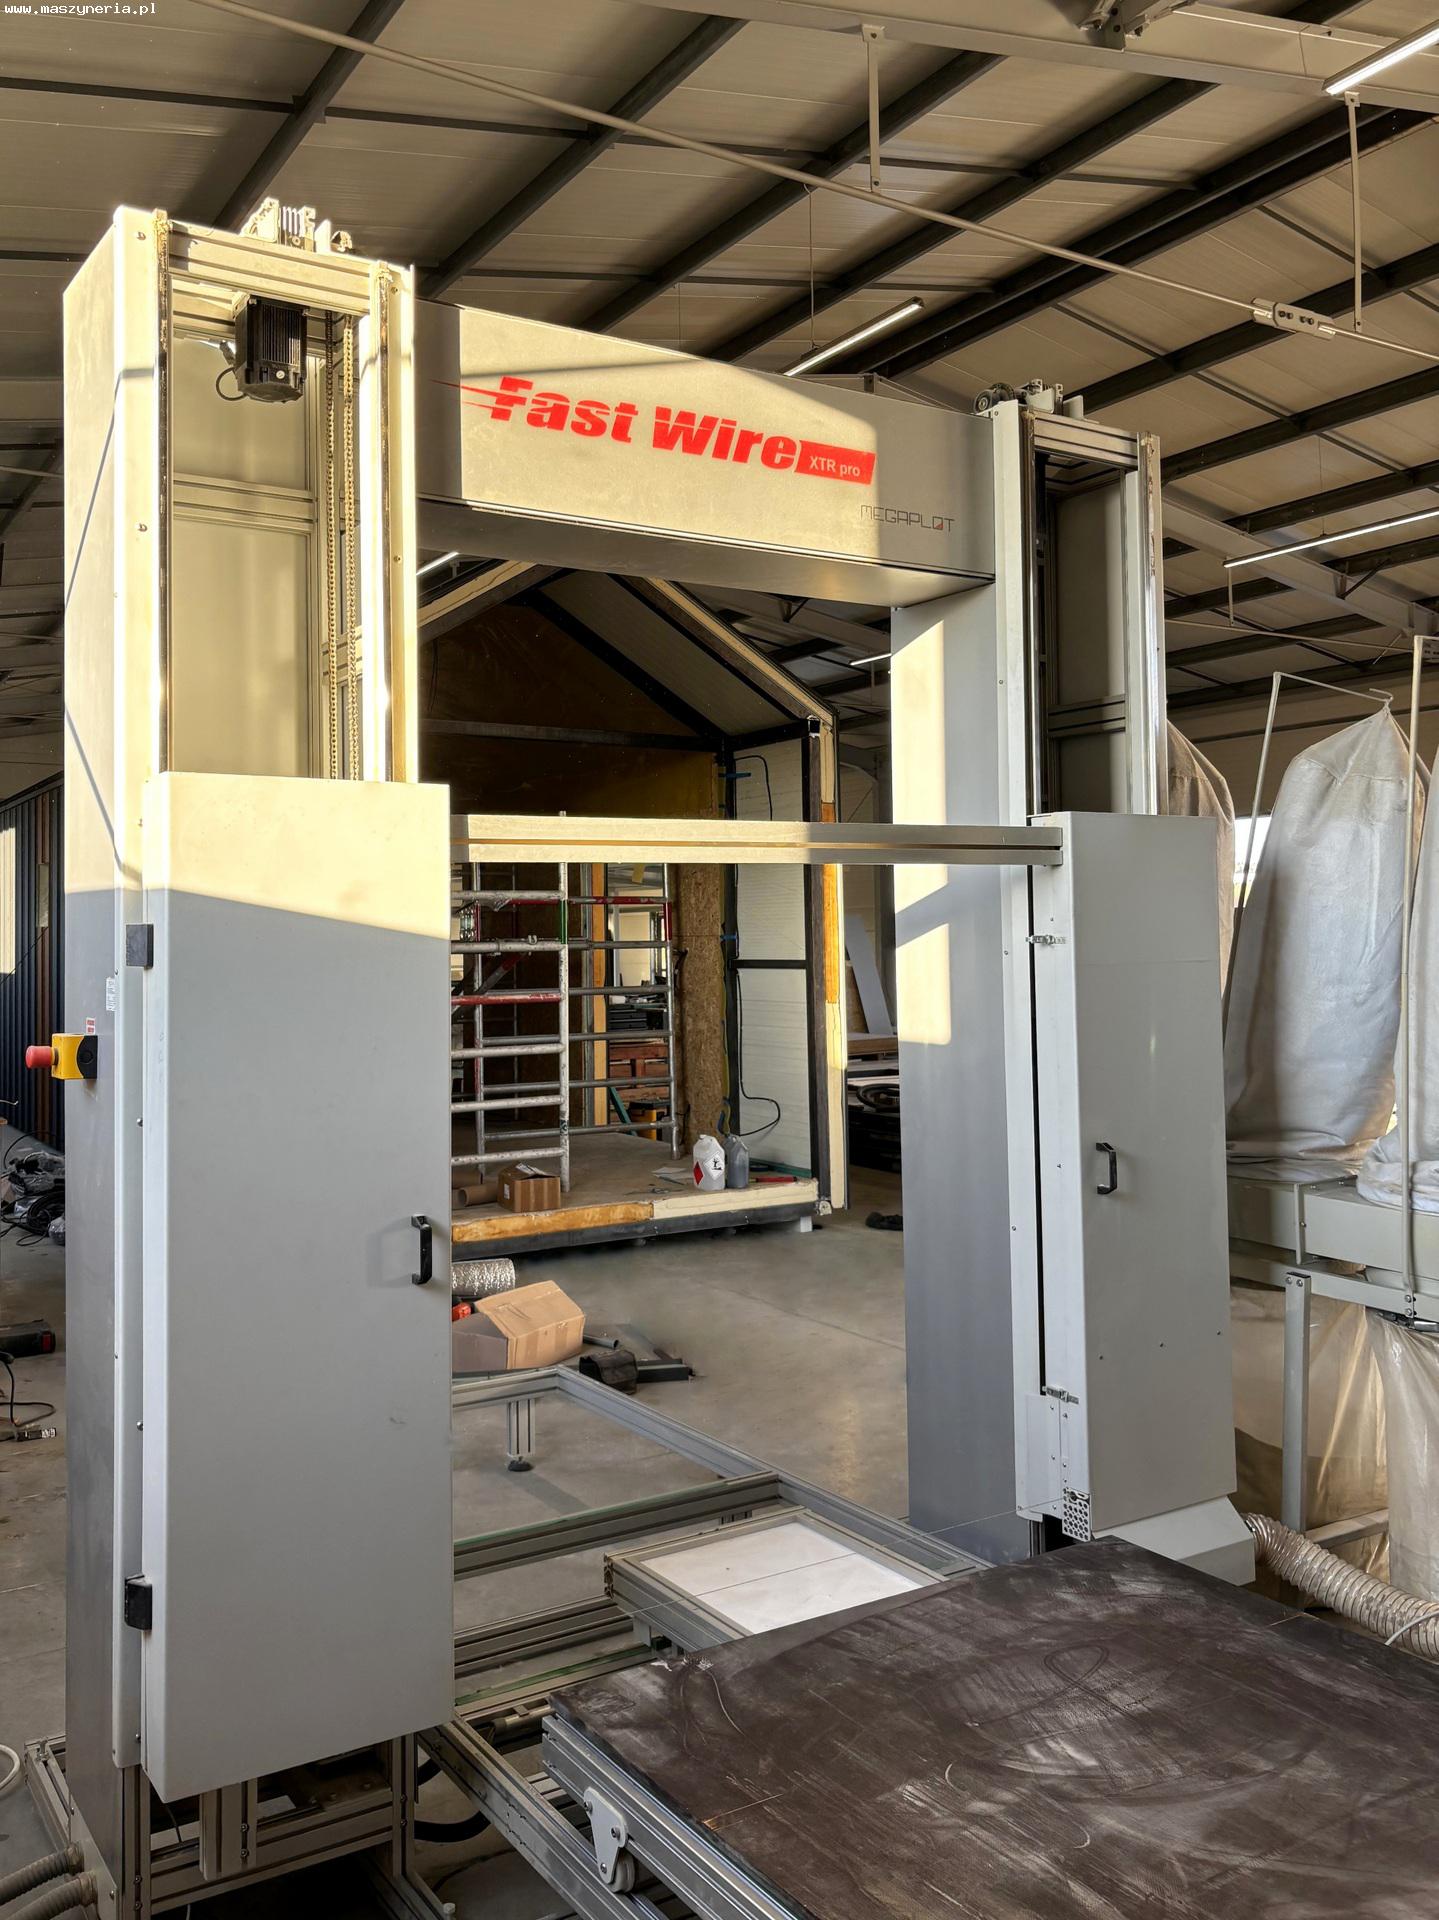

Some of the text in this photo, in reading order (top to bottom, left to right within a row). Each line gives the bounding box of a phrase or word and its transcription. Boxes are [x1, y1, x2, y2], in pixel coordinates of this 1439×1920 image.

[489, 375, 861, 478] Fast Wire XTR pro
[860, 503, 956, 534] MEGAPLOT
